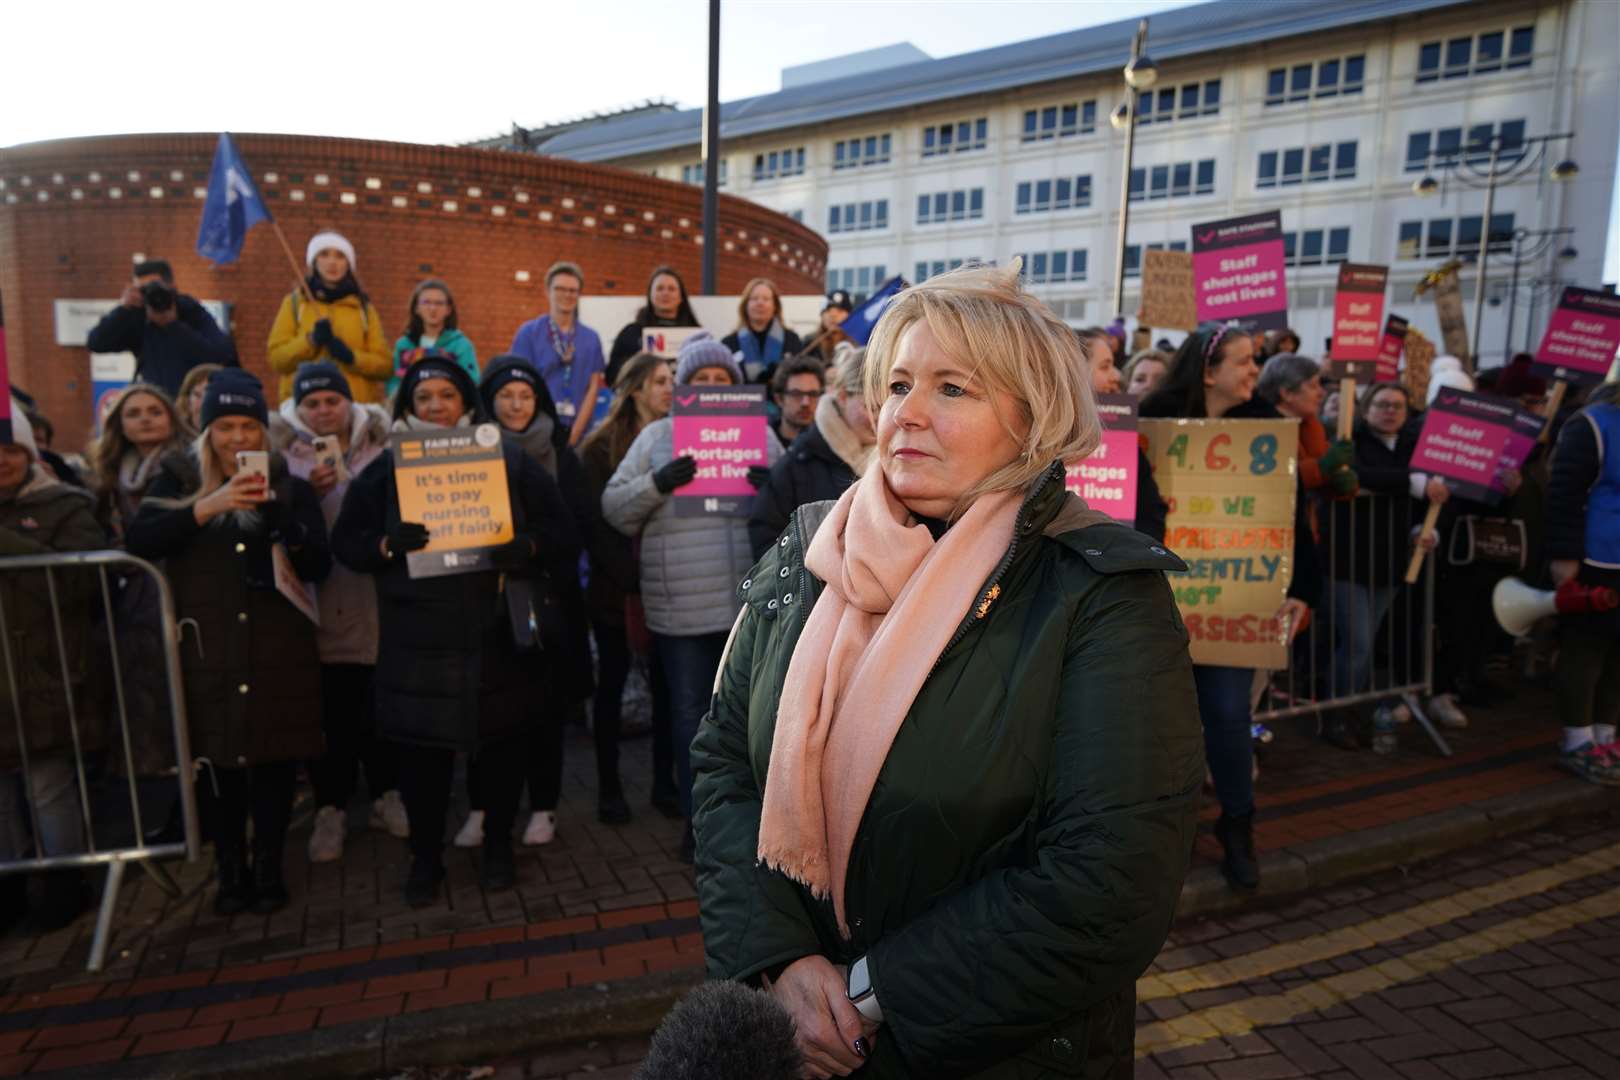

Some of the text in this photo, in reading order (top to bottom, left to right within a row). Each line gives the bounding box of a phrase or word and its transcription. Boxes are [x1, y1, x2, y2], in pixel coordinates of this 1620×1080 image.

[1220, 254, 1257, 272] Staff
[1202, 269, 1277, 291] shortages
[1206, 285, 1276, 307] cost lives
[699, 392, 762, 402] SAFE STAFFING
[700, 427, 741, 443] Staff
[1449, 423, 1484, 441] Staff
[424, 438, 449, 449] FAIR
[450, 436, 472, 448] PAY
[1427, 434, 1494, 459] shortages
[1249, 433, 1279, 476] 8
[1424, 447, 1453, 463] cost
[1454, 453, 1486, 472] lives
[416, 470, 488, 487] It's time
[693, 463, 751, 478] ost live
[1065, 464, 1127, 482] ortages
[426, 489, 481, 504] to pay
[1083, 482, 1123, 500] lives
[422, 504, 490, 521] nursing
[1223, 496, 1255, 517] WE
[429, 519, 503, 538] aff fairly
